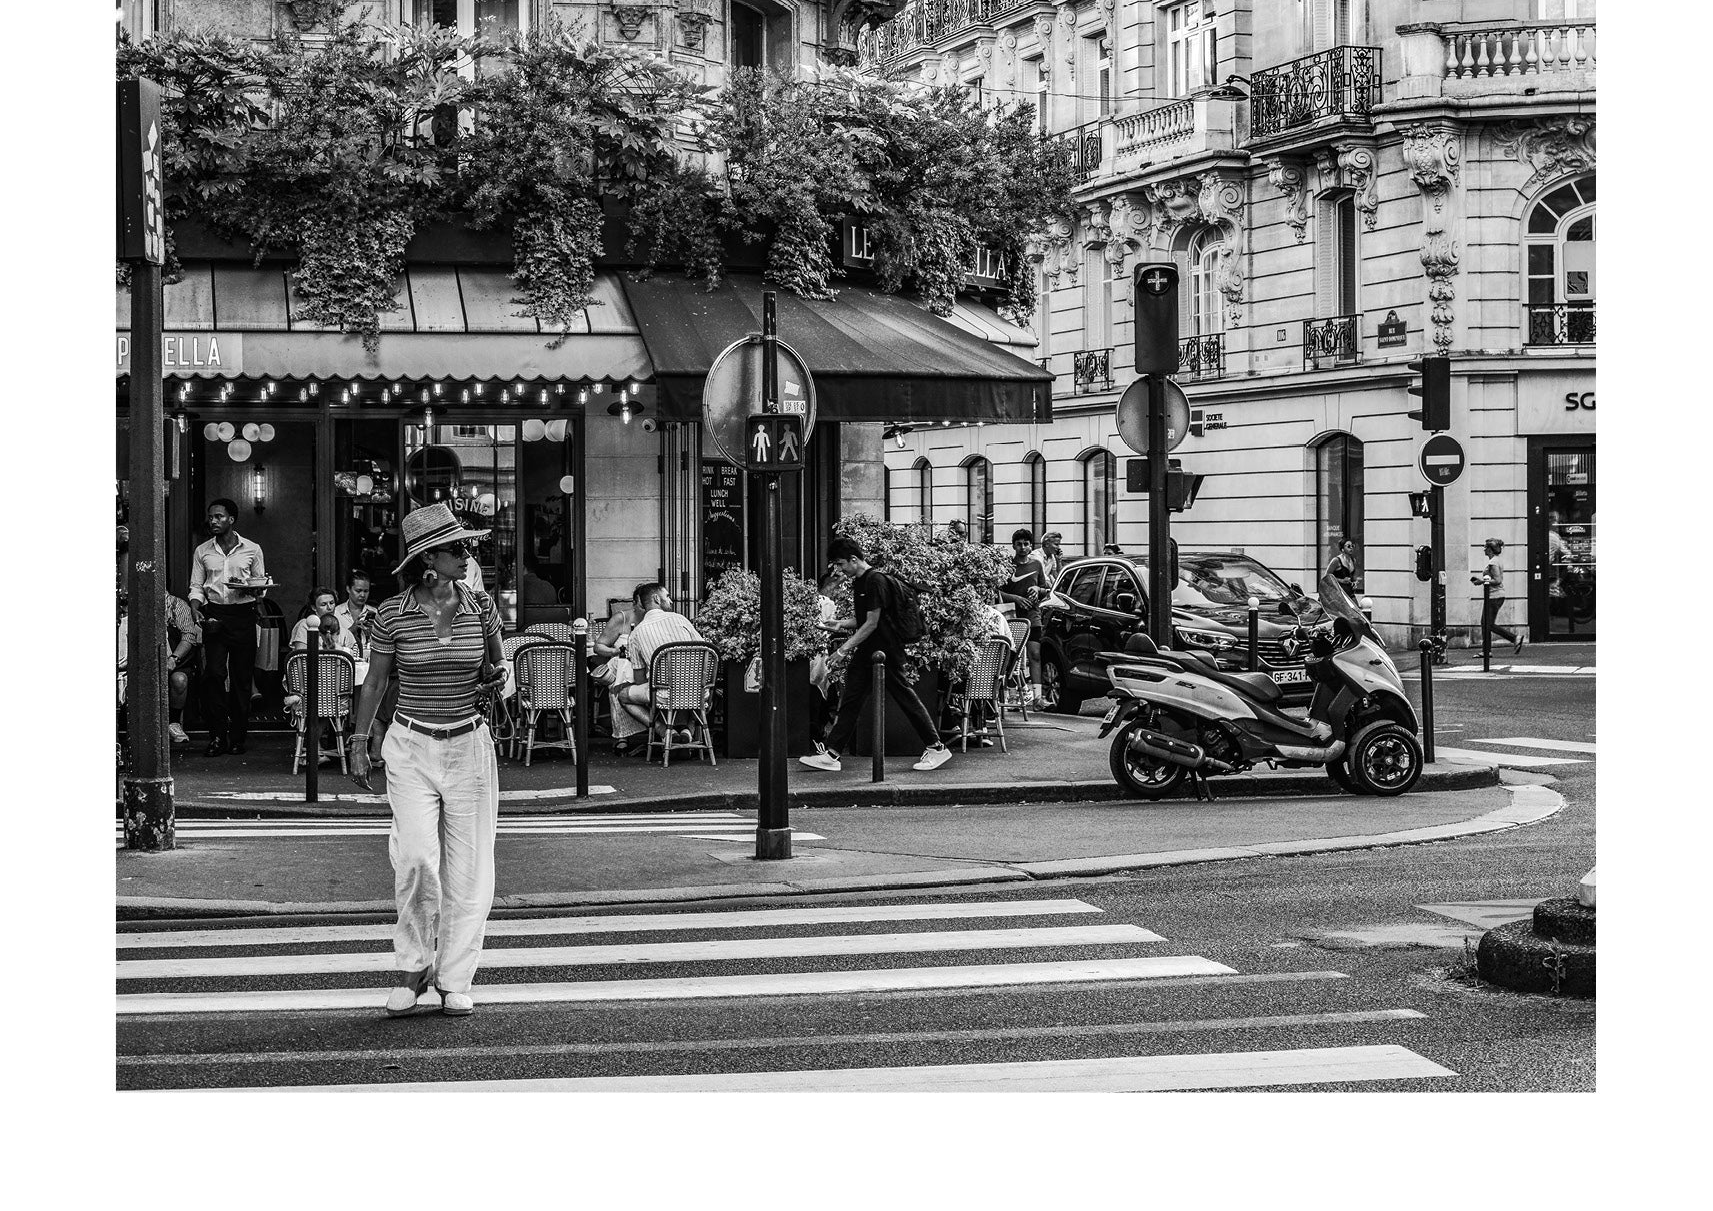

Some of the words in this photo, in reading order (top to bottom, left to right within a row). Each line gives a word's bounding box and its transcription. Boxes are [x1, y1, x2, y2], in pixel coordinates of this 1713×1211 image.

[851, 226, 875, 260] LE
[1565, 392, 1596, 412] SG
[702, 465, 714, 474] RINK
[721, 466, 738, 475] BREAK
[723, 477, 736, 486] FAST
[710, 489, 729, 498] LUNCH
[710, 499, 726, 508] WELL
